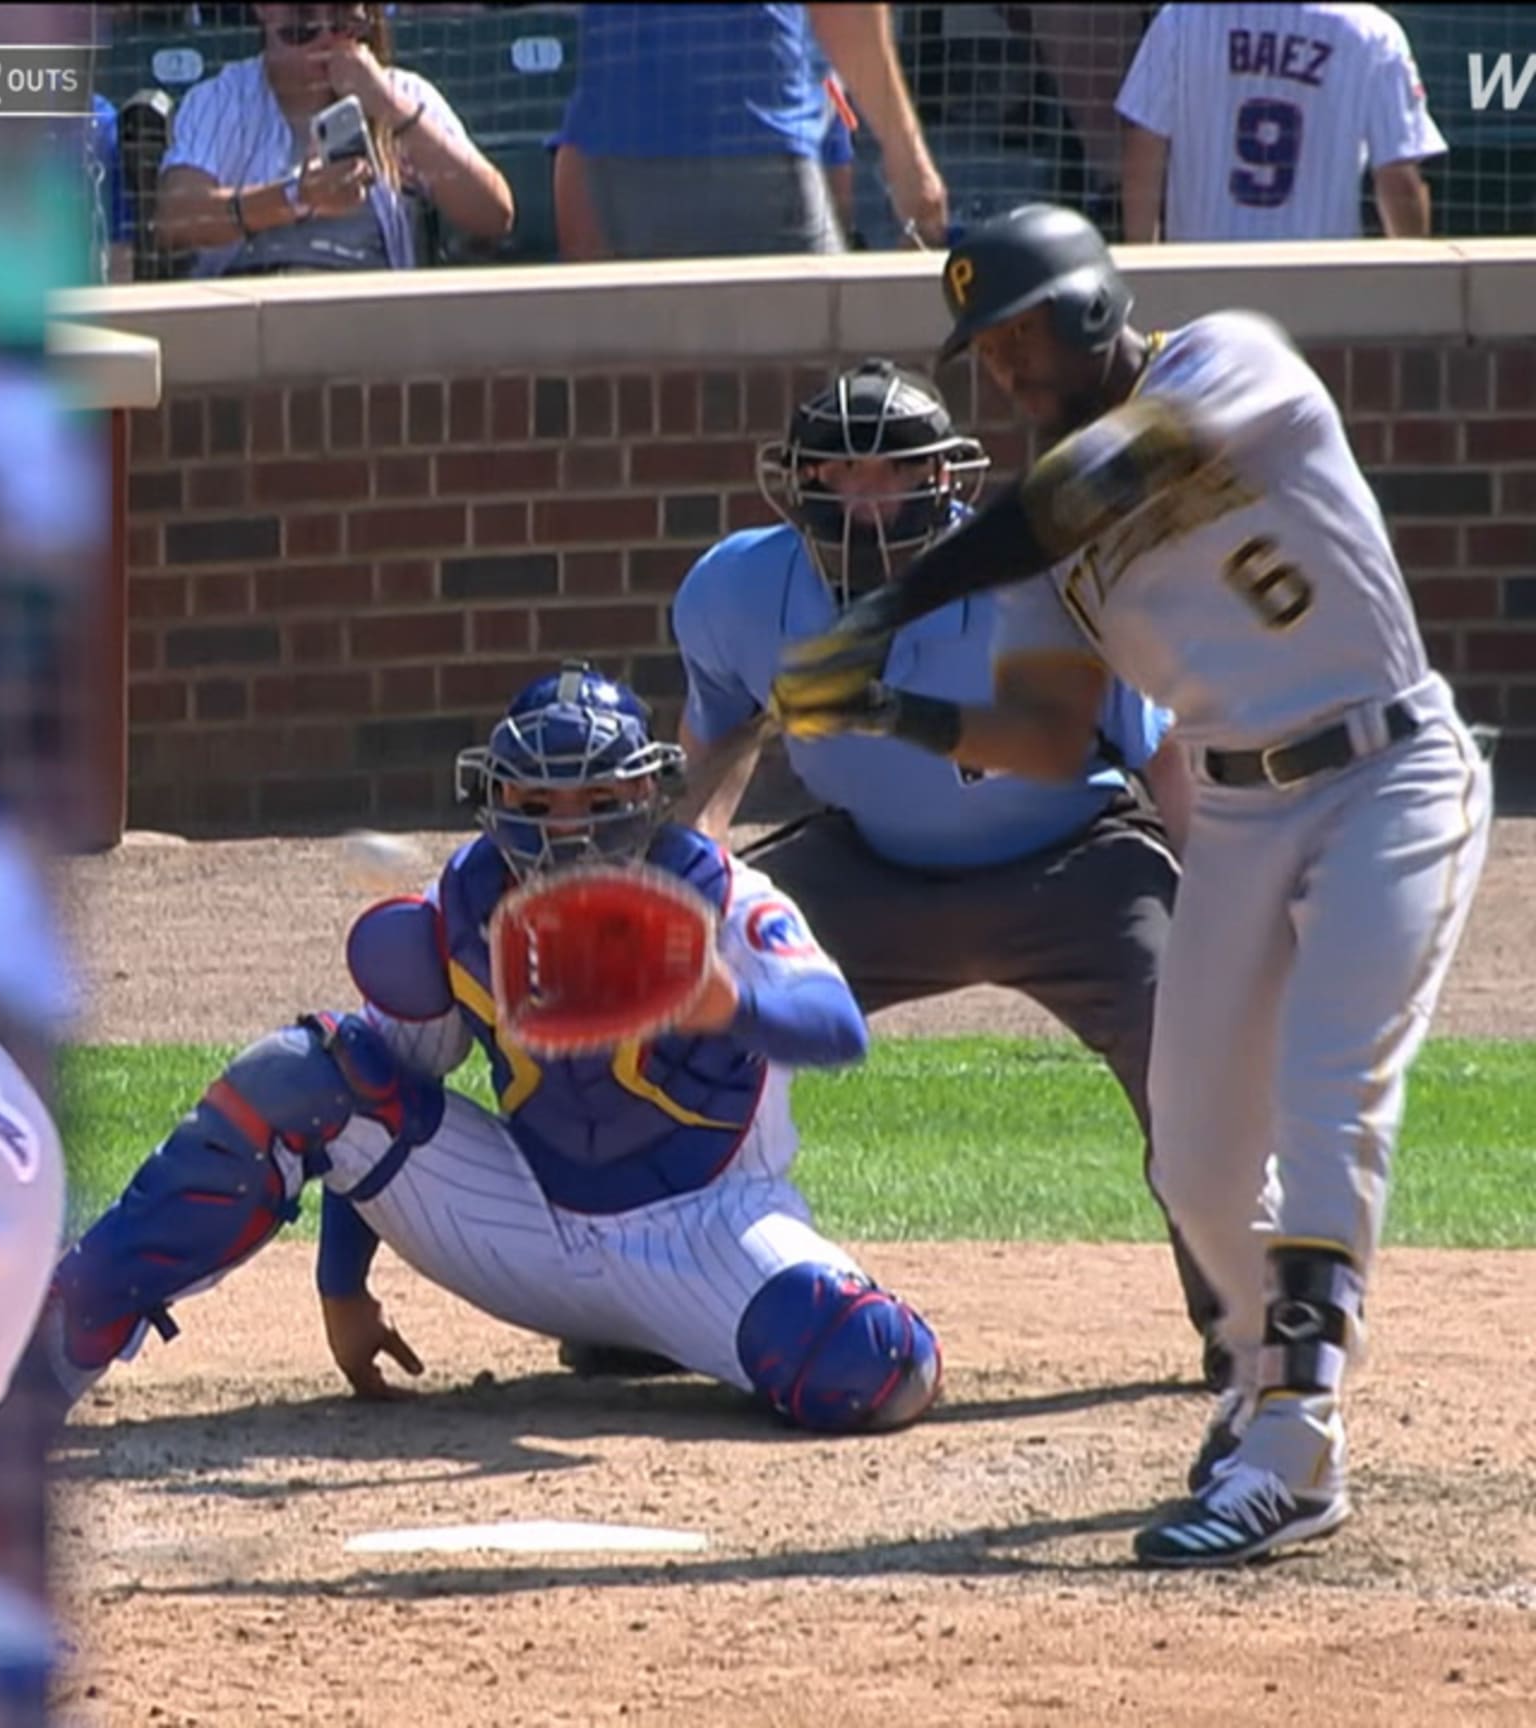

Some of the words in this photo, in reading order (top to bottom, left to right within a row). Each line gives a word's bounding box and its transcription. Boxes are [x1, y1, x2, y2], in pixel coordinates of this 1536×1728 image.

[1228, 29, 1333, 88] BAEZ
[1228, 97, 1304, 209] 9
[949, 258, 973, 306] P
[1221, 532, 1317, 636] 6
